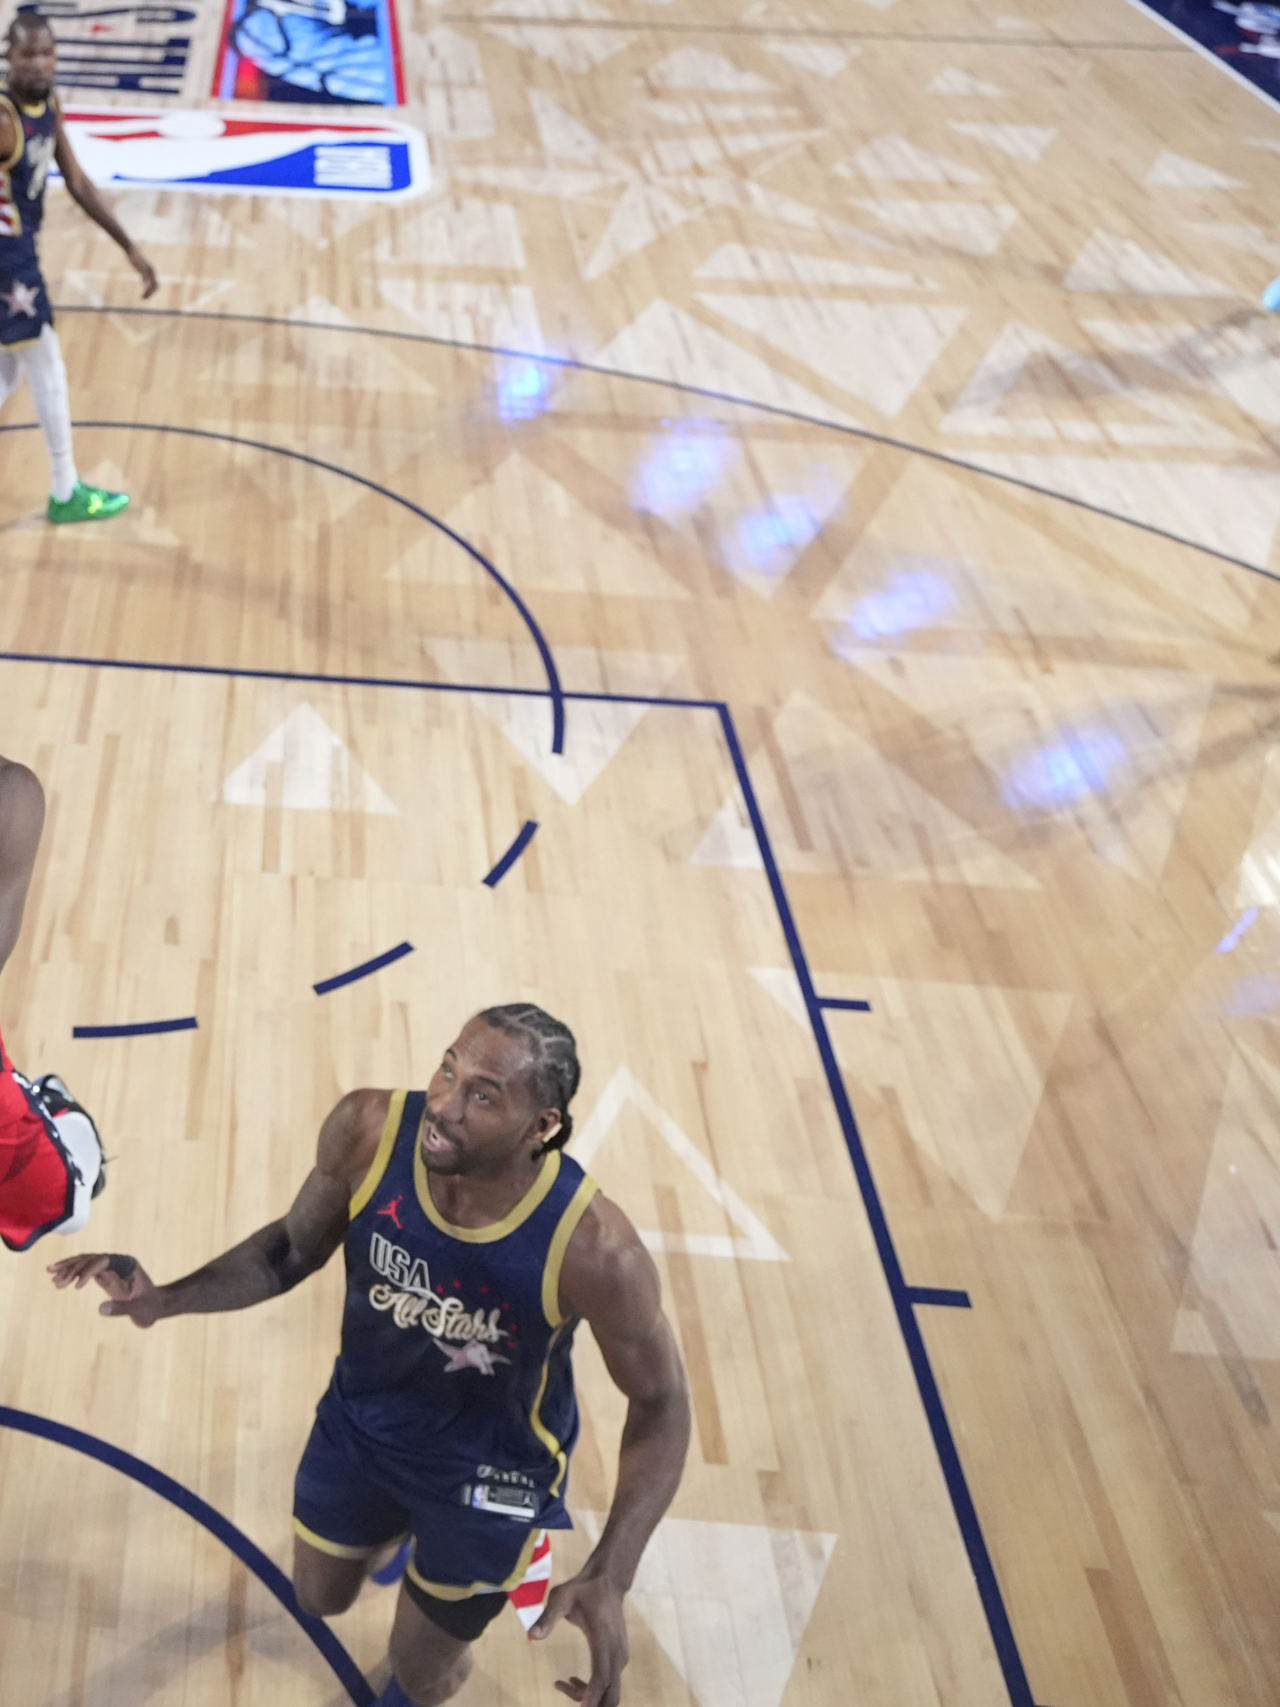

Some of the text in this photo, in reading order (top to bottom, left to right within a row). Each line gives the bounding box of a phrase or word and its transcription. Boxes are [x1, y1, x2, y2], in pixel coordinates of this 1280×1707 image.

[369, 1232, 431, 1297] USA
[369, 1284, 509, 1343] All Stars
